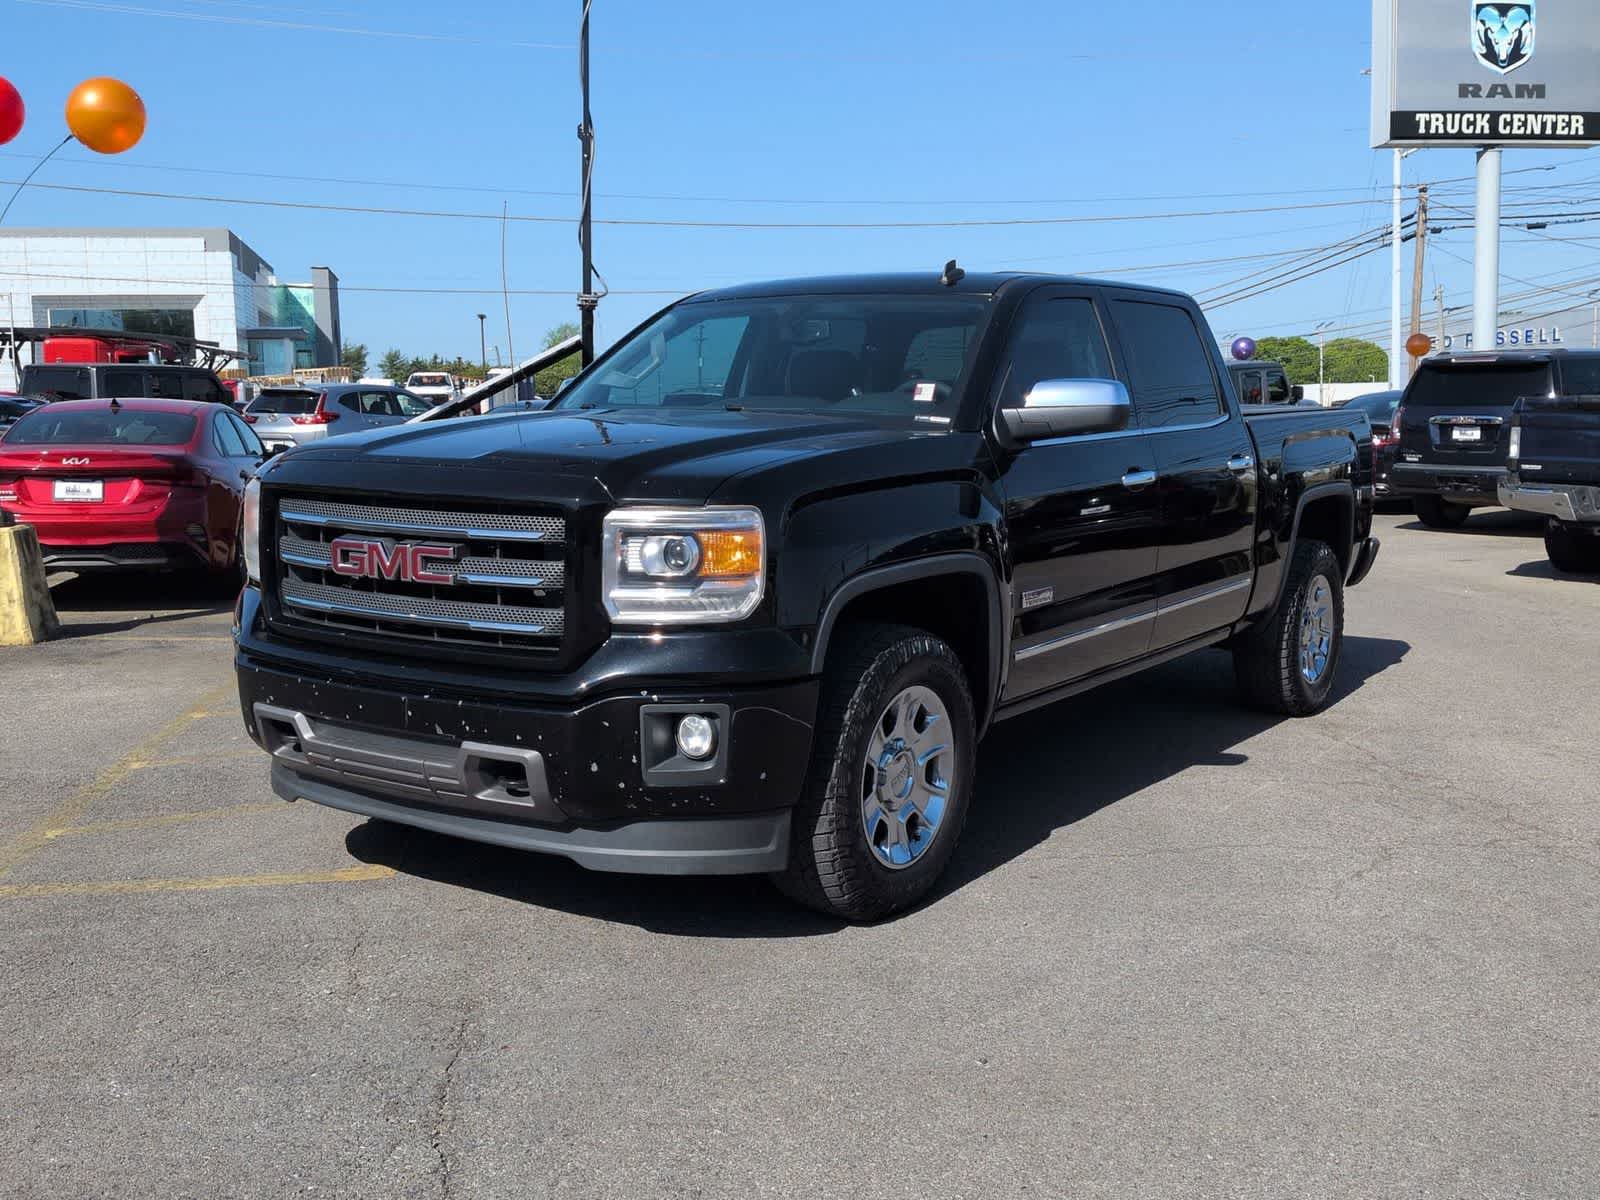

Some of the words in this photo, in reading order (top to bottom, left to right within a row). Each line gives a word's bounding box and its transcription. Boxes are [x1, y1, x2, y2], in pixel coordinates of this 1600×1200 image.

[1457, 83, 1547, 99] RAM
[1415, 113, 1491, 135] TRUCK
[1498, 114, 1585, 136] CENTER
[62, 457, 90, 465] KIA
[330, 535, 457, 585] GMC
